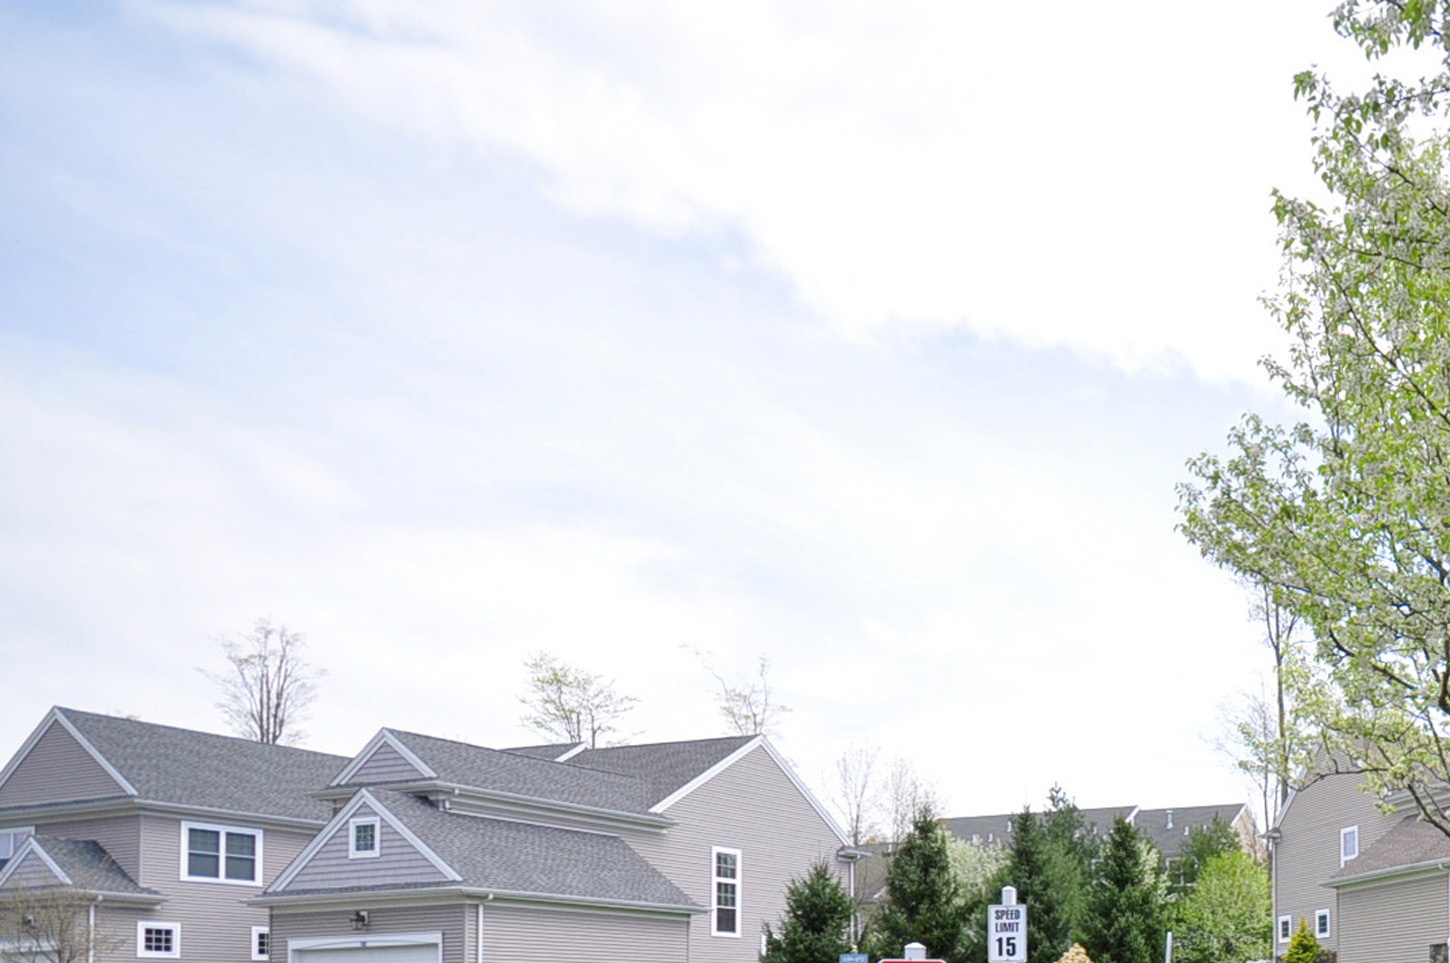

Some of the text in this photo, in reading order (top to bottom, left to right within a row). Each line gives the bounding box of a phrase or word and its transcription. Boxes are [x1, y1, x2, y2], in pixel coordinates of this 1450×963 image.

[994, 909, 1020, 920] SPEED
[995, 922, 1020, 933] LIMIT
[996, 937, 1017, 957] 15
